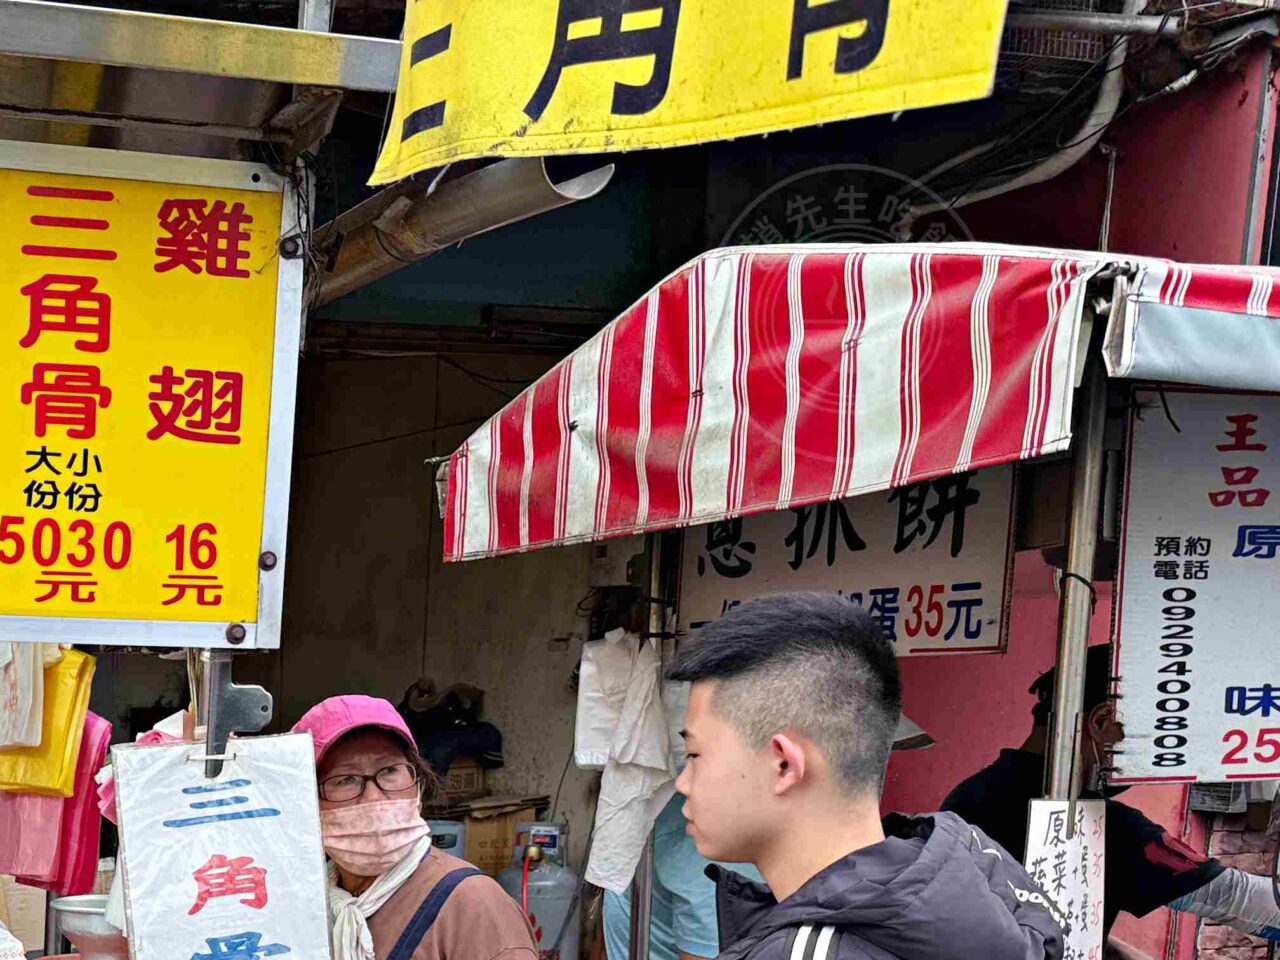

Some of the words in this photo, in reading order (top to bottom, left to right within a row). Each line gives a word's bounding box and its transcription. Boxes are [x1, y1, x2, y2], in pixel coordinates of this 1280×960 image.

[20, 185, 118, 439] 三角骨
[146, 198, 252, 445] 雞翅
[23, 445, 62, 510] 大份
[64, 448, 103, 513] 小份
[1208, 413, 1270, 507] 王品
[1153, 536, 1212, 557] 預約
[1153, 560, 1210, 580] 電話
[1151, 587, 1197, 767] 0929400808
[1221, 726, 1280, 765] 25
